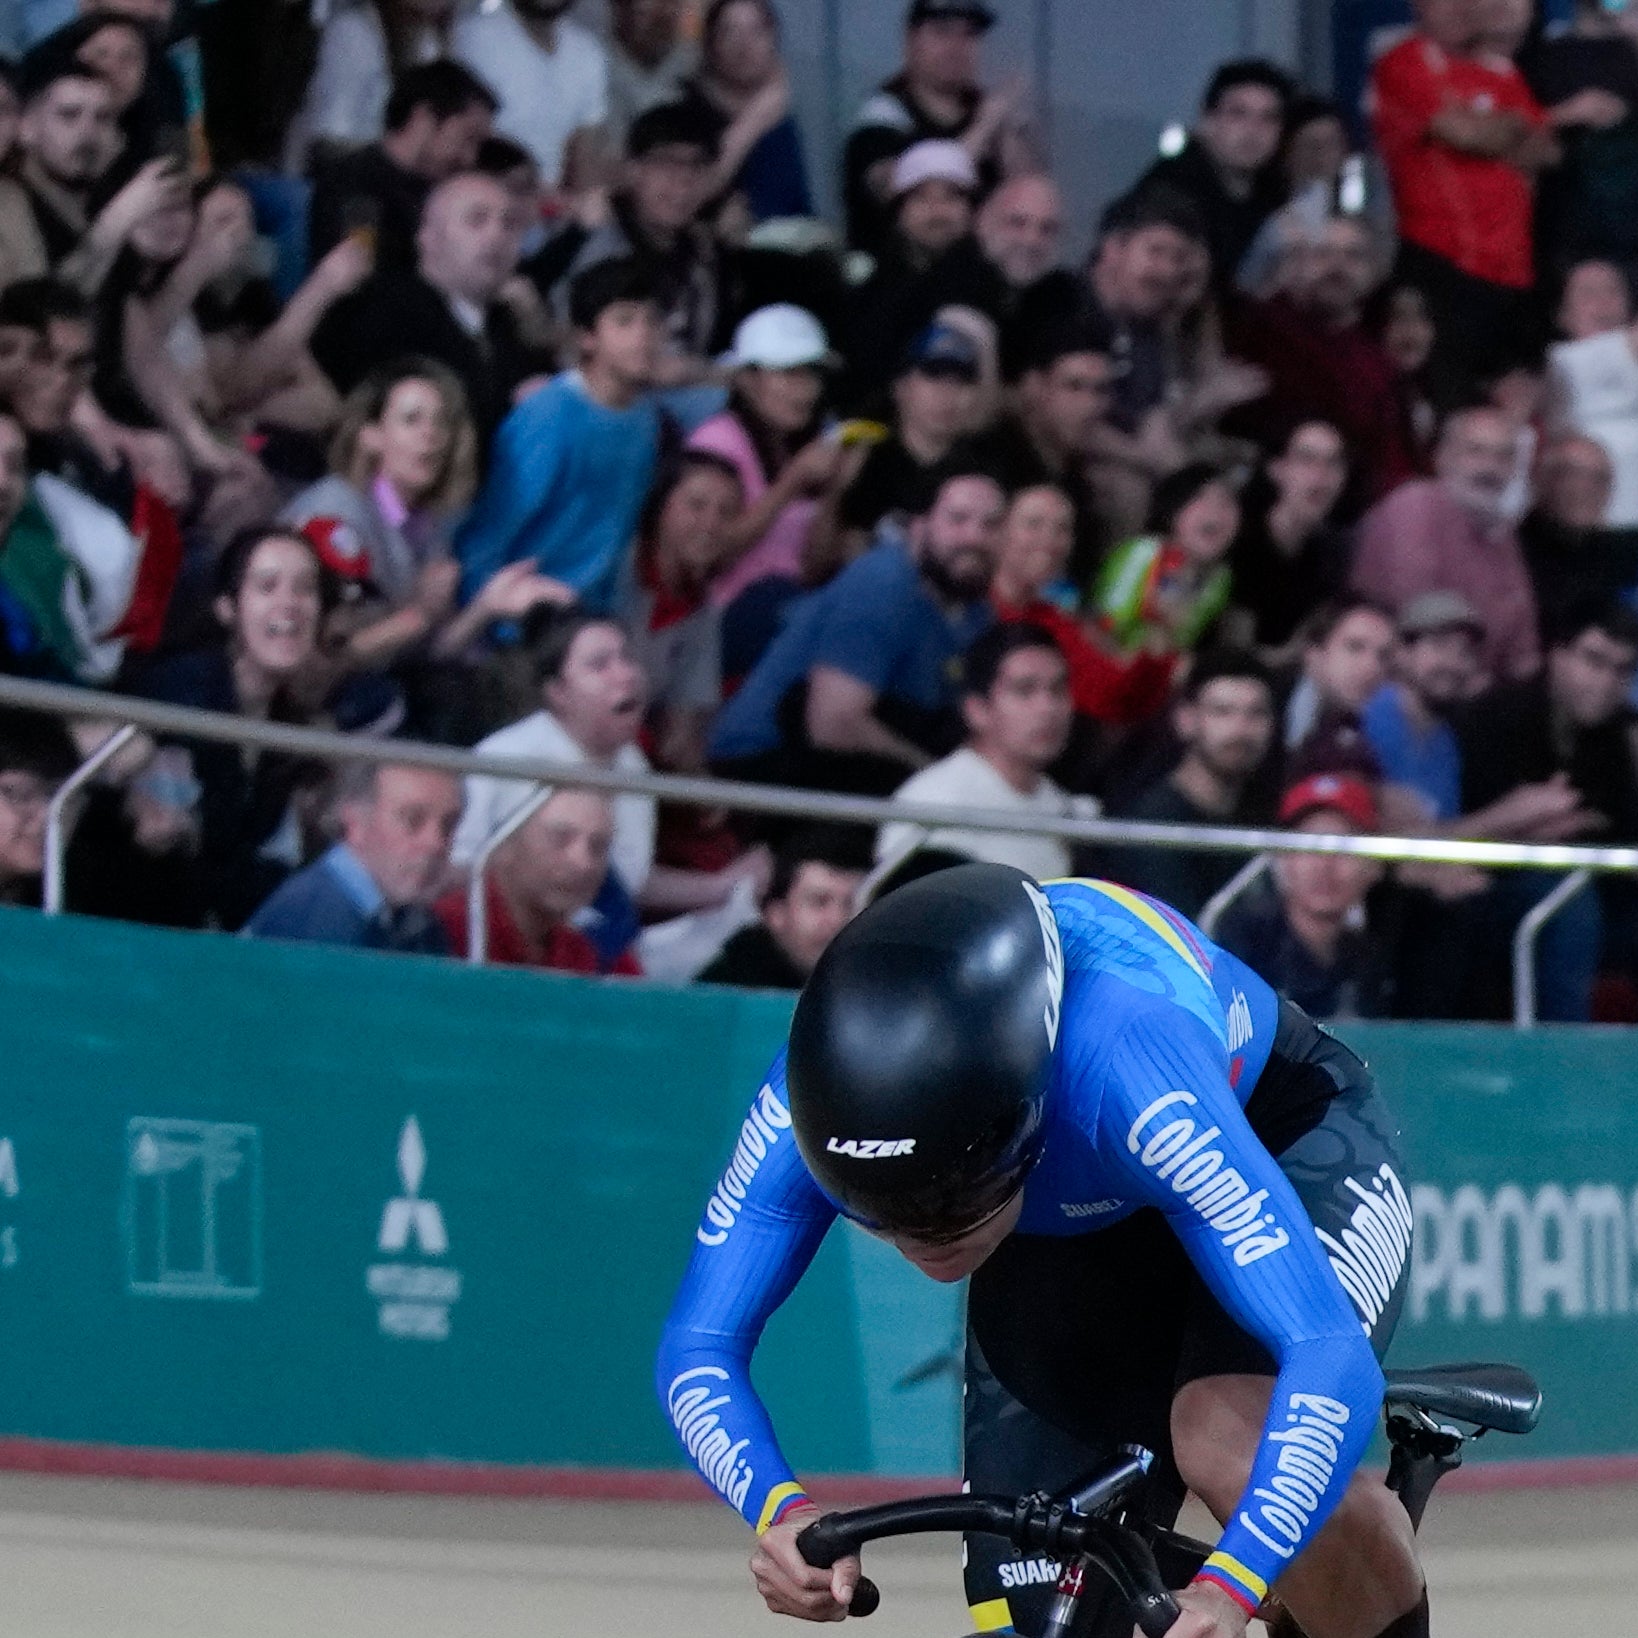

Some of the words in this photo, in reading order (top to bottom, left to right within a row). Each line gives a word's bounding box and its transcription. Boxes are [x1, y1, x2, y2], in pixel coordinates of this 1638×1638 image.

[826, 1137, 917, 1169] LAZER
[1126, 1090, 1290, 1268] Colombia
[1314, 1162, 1414, 1339] olombia
[668, 1365, 754, 1514] Colombia
[1239, 1392, 1351, 1559] Colombia
[998, 1558, 1062, 1588] SUAR
